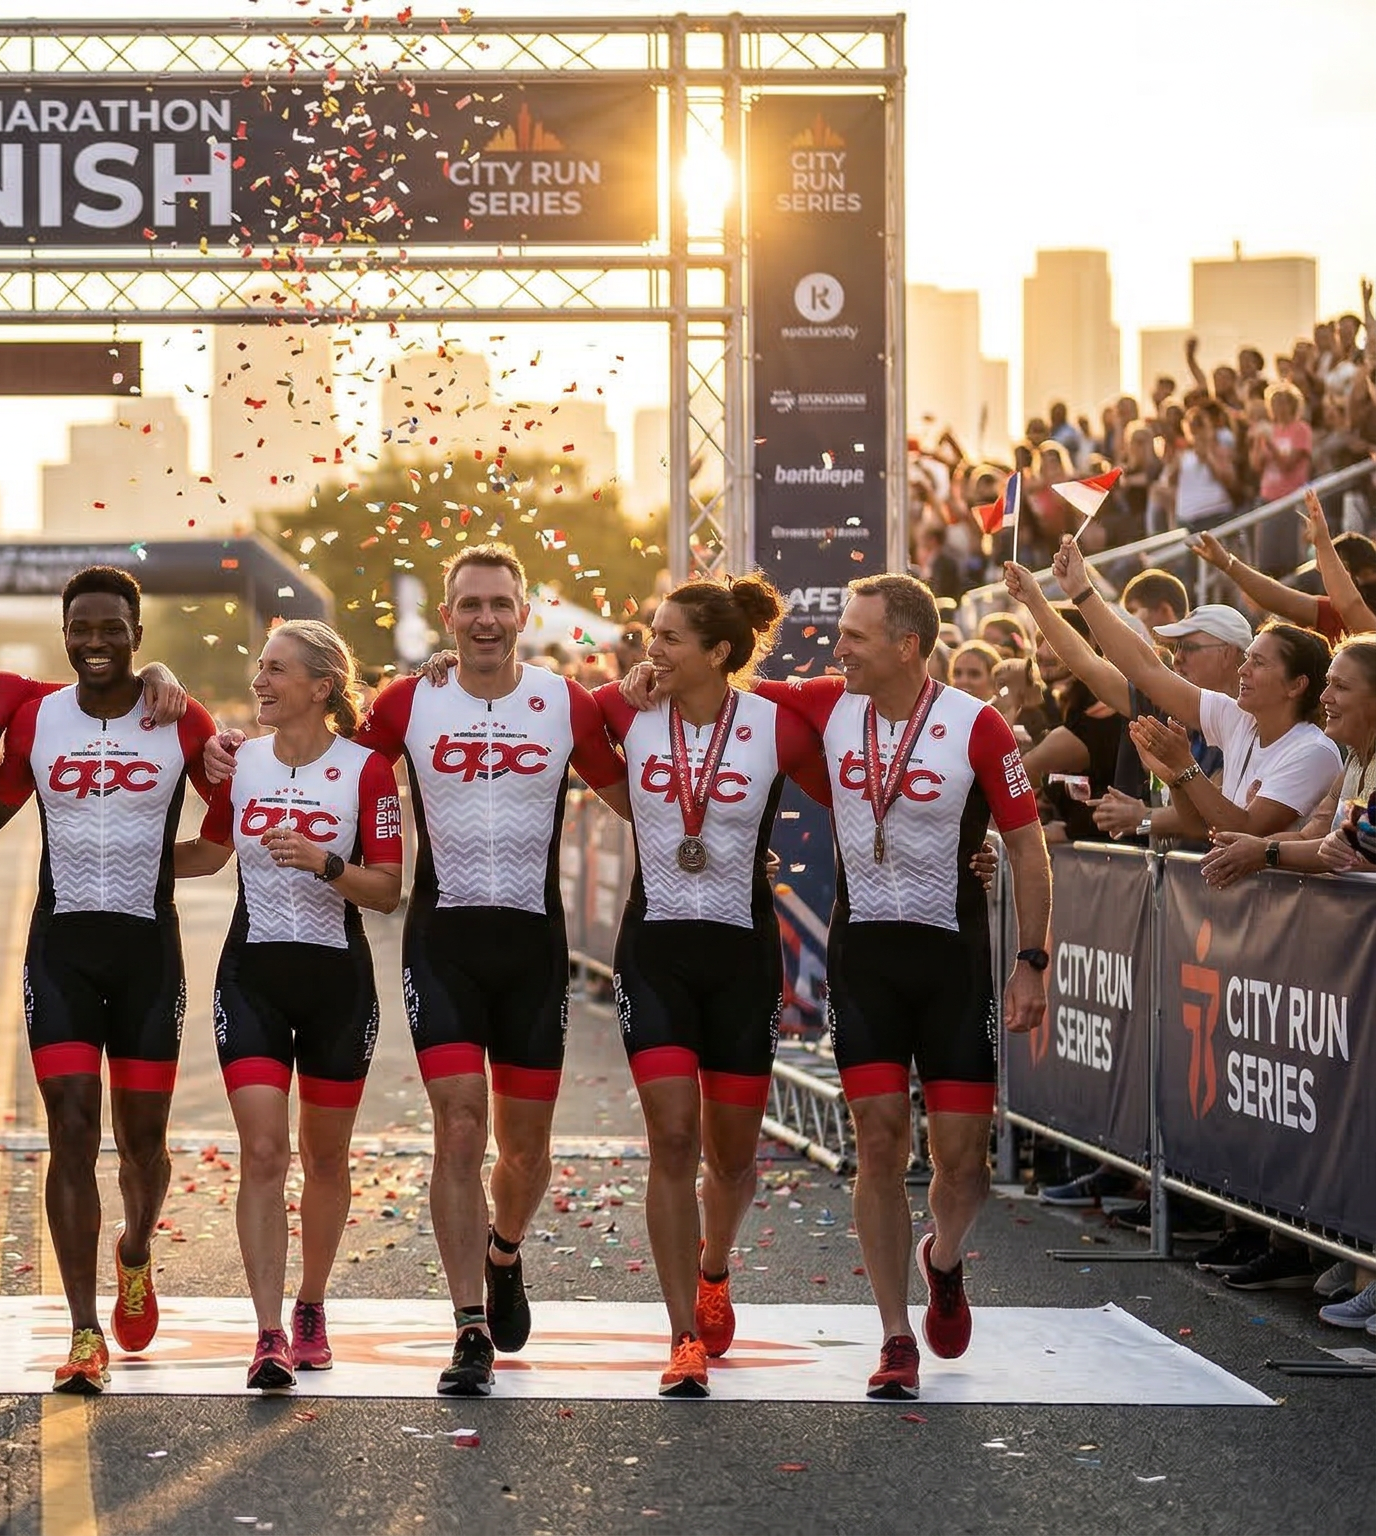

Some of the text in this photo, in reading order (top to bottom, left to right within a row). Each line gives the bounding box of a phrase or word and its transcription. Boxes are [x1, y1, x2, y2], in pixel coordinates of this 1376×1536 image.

[448, 160, 601, 186] CITY RUN
[791, 151, 847, 170] CITY
[793, 172, 845, 191] RUN
[468, 191, 582, 216] SERIES
[776, 193, 862, 213] SERIES
[838, 749, 944, 803] bc
[1056, 941, 1133, 1012] CITY RUN
[1056, 1004, 1113, 1073] SERIES
[1225, 975, 1350, 1062] CITY RUN
[1226, 1049, 1318, 1134] SERIES
